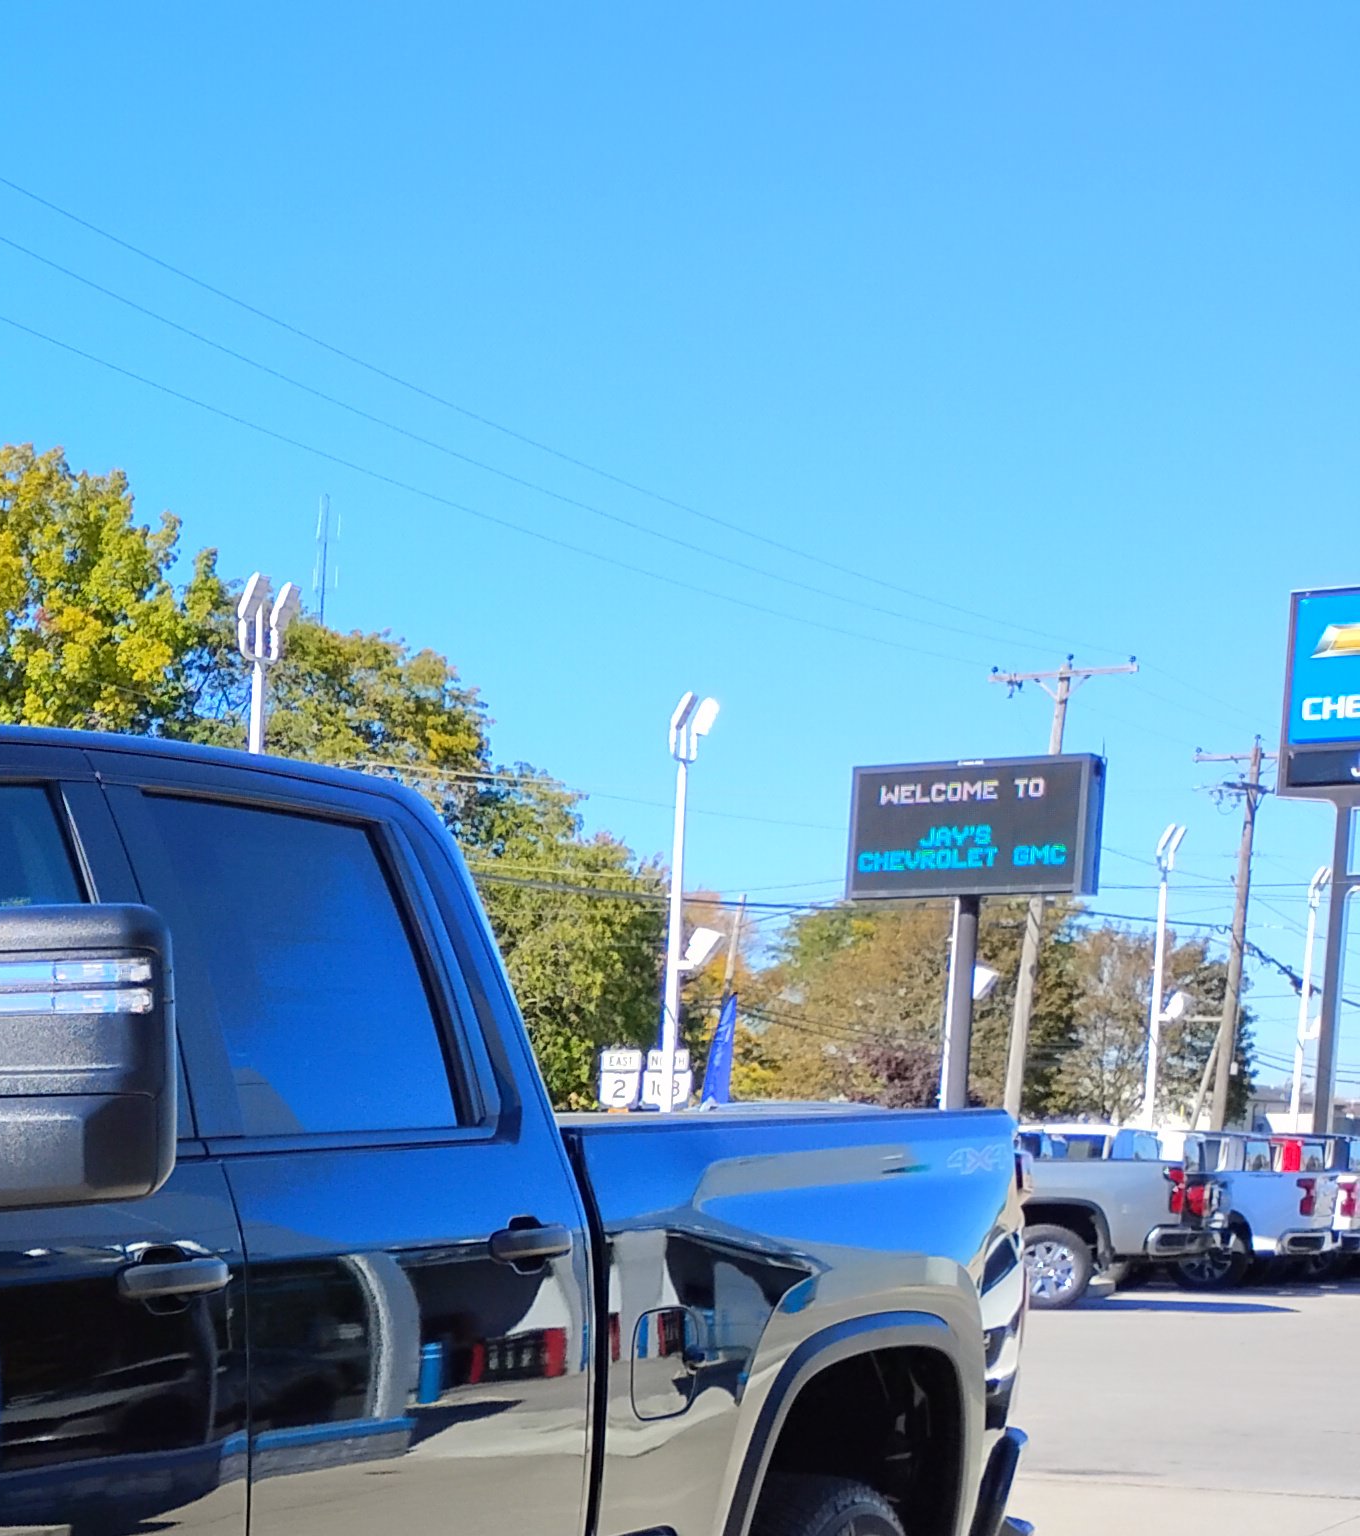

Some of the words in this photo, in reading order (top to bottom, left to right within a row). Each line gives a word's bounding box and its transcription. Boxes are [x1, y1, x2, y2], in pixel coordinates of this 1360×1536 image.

[880, 779, 999, 805] WELCOME
[1014, 778, 1045, 799] TO
[919, 824, 992, 848] JAY'S
[857, 846, 999, 874] CHEVROLET
[1012, 844, 1067, 866] GMC
[608, 1056, 633, 1067] EAST
[611, 1079, 627, 1099] 2
